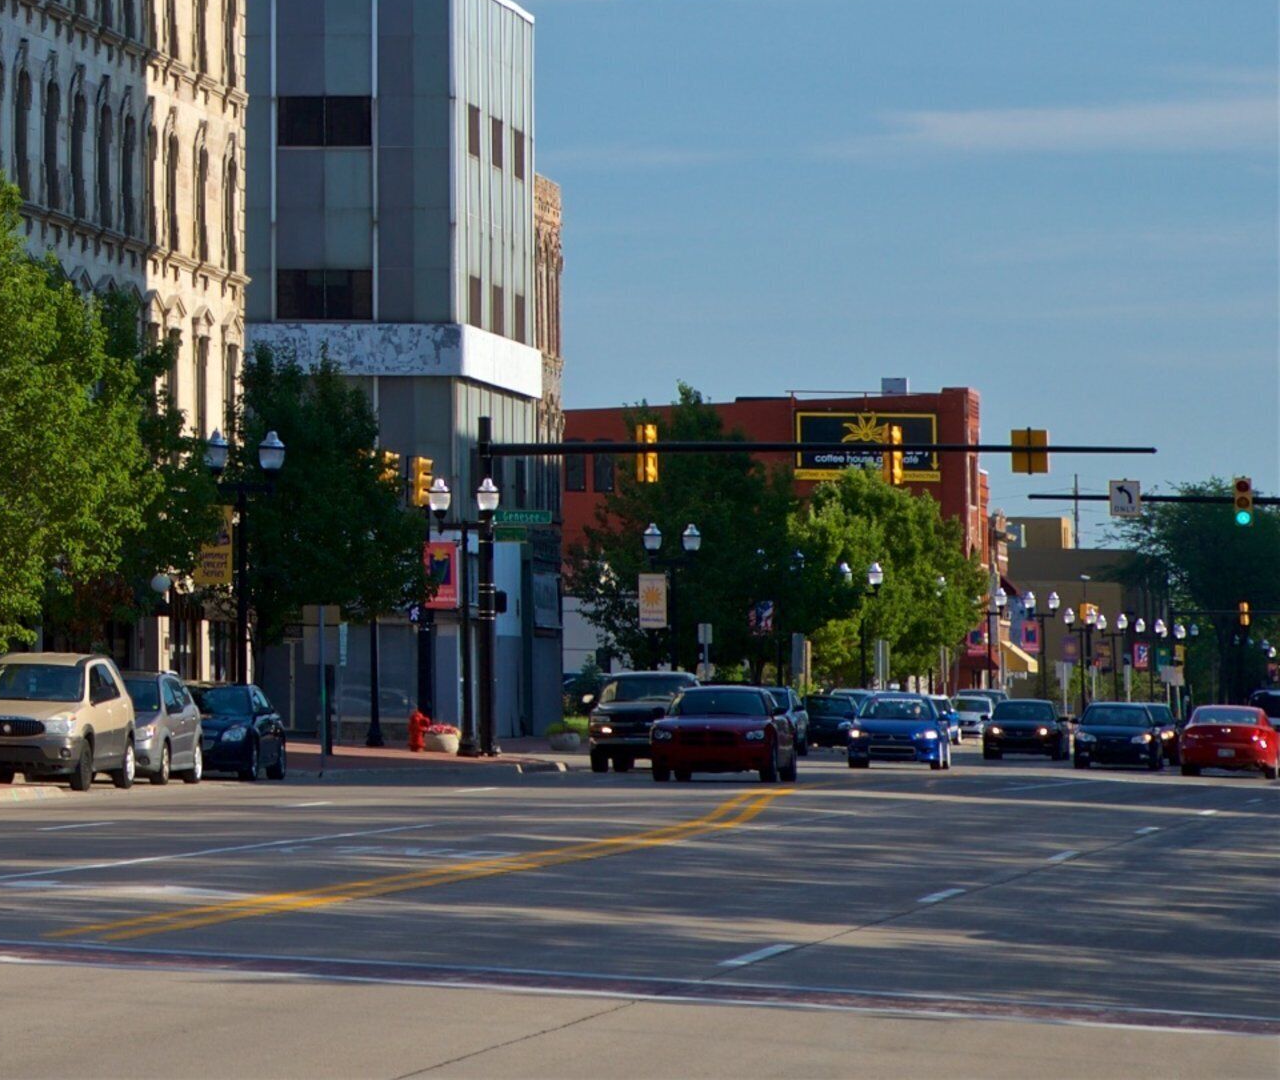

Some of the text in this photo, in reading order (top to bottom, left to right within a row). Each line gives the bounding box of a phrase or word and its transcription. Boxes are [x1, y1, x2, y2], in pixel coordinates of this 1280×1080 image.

[815, 454, 845, 463] coffee
[846, 453, 875, 463] house
[503, 511, 539, 523] Genesee
